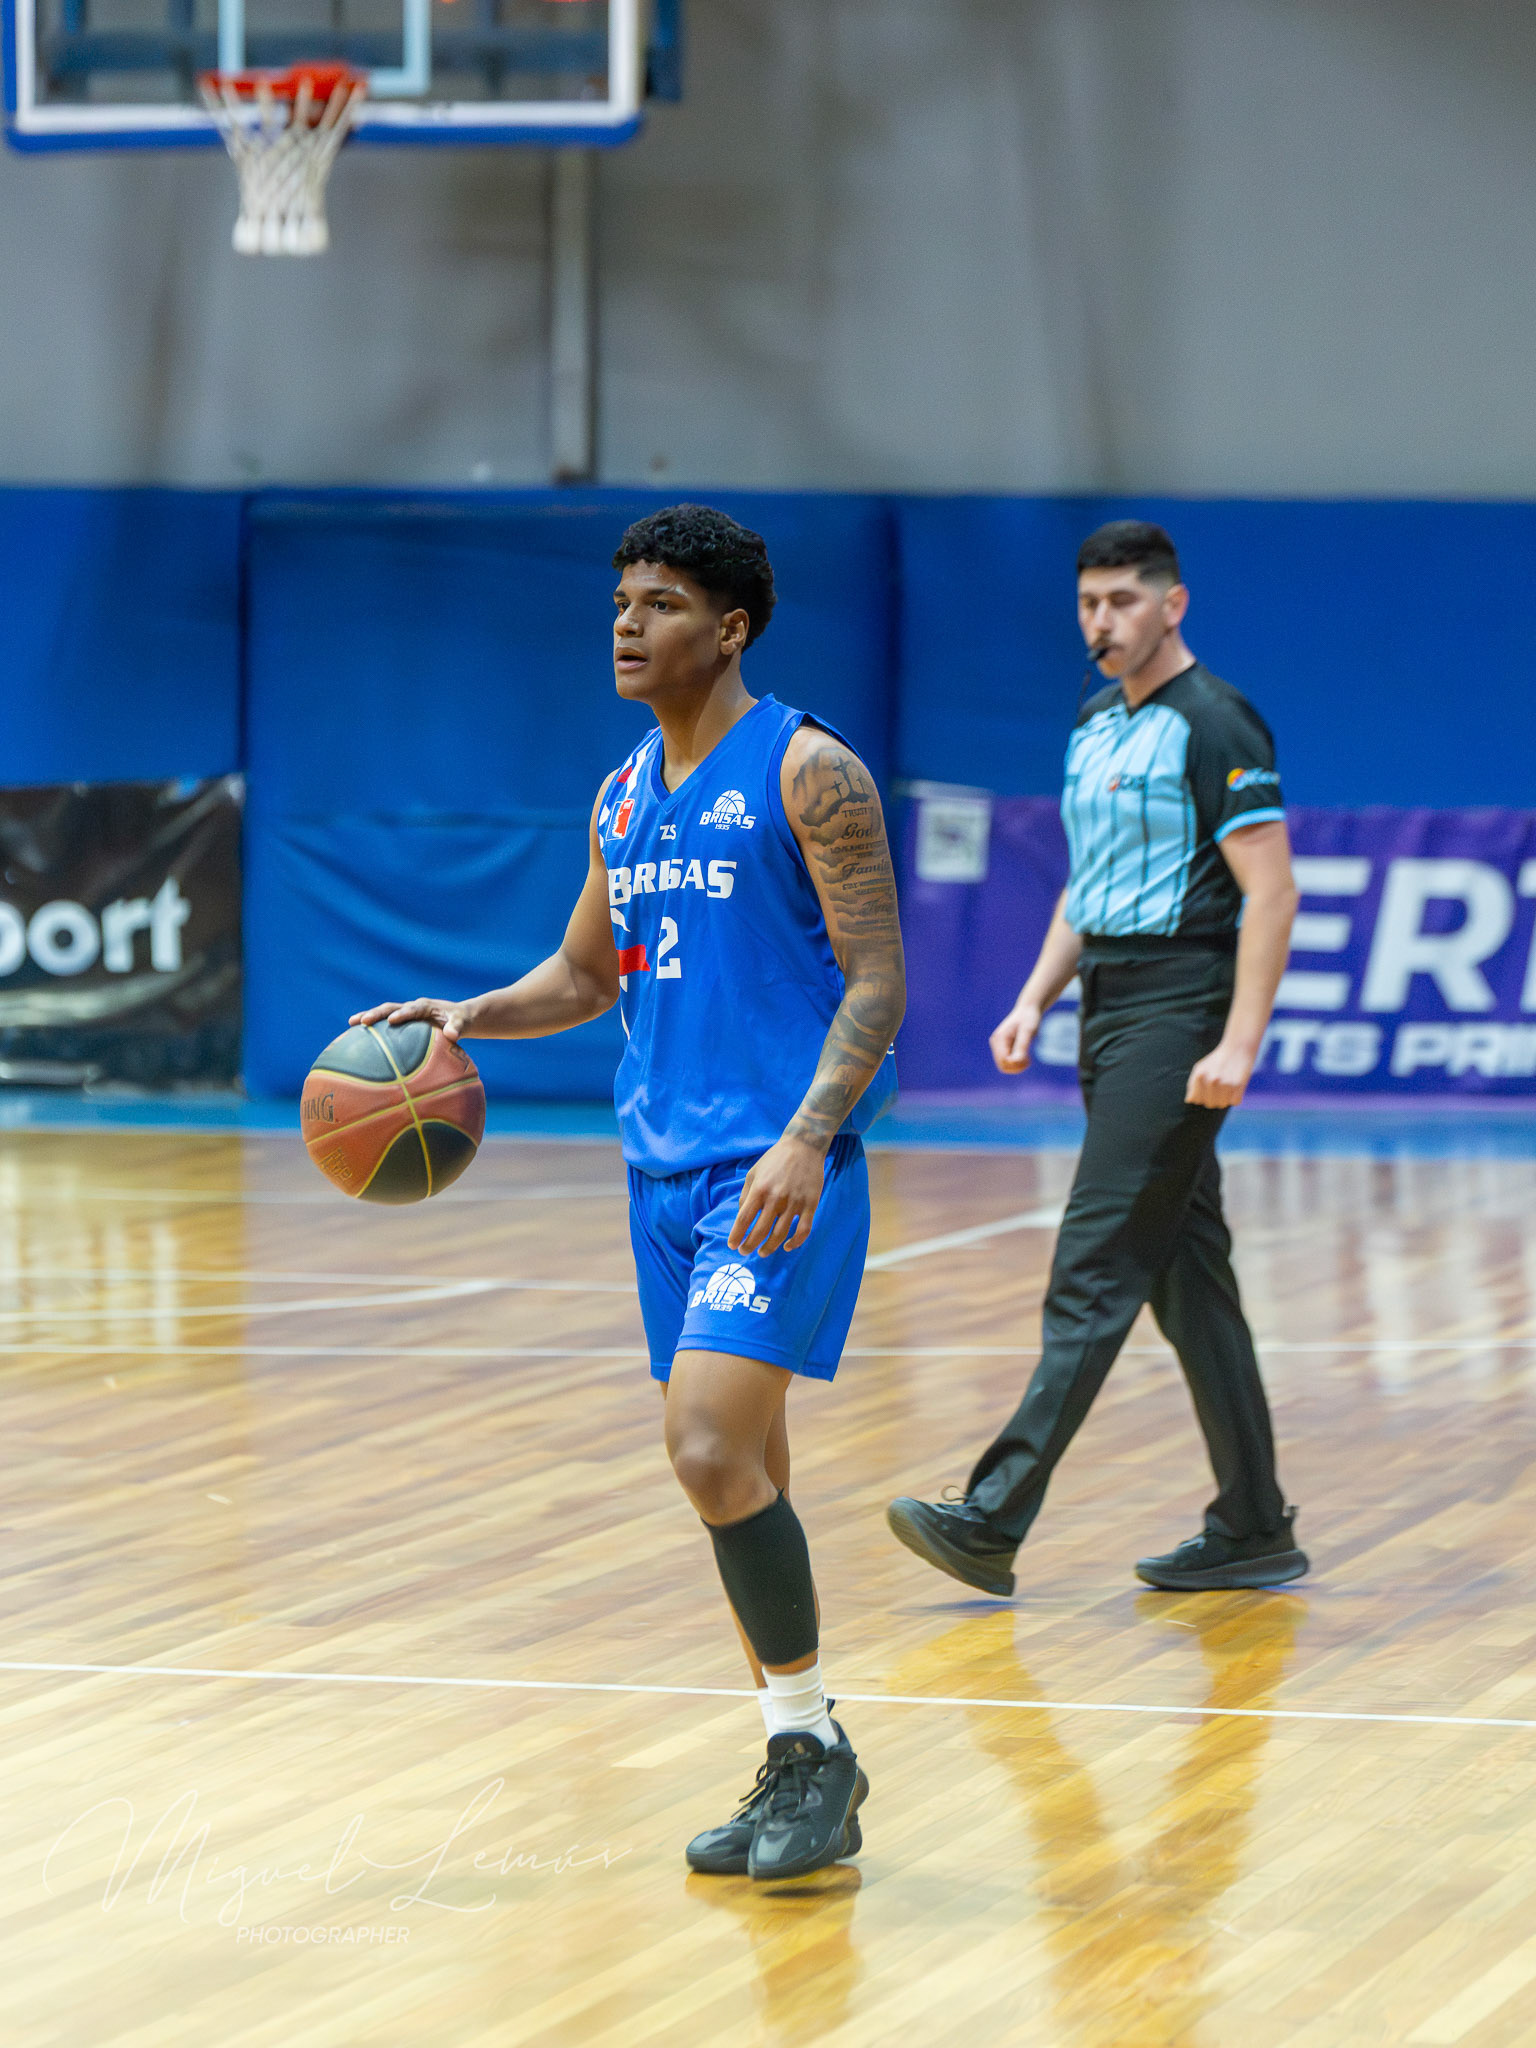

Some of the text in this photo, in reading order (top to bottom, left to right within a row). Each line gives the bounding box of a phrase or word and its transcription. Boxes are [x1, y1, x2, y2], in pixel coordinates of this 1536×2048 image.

[699, 811, 757, 830] BRISAS
[656, 916, 682, 979] 2
[689, 1289, 772, 1314] BRISAS
